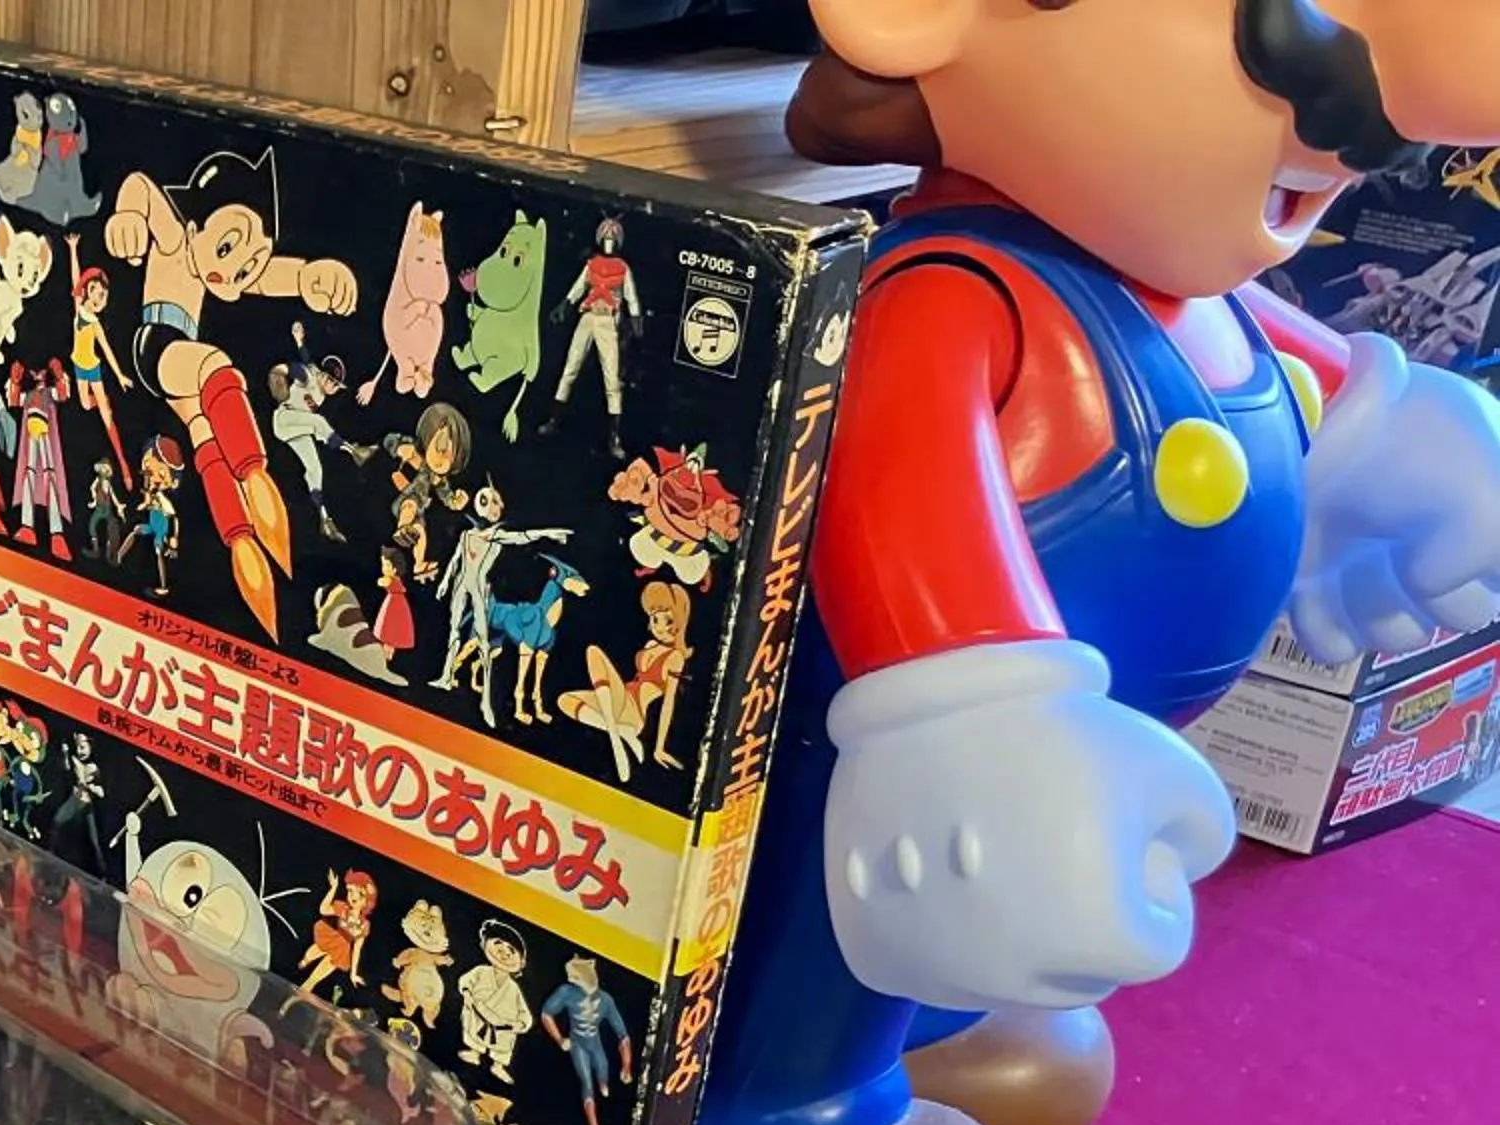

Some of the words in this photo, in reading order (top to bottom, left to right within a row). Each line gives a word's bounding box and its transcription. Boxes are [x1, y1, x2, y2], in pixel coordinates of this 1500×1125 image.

[137, 609, 300, 687] オリジナル原盤による
[664, 383, 833, 1096] テレビまんが主題歌のあゆみ
